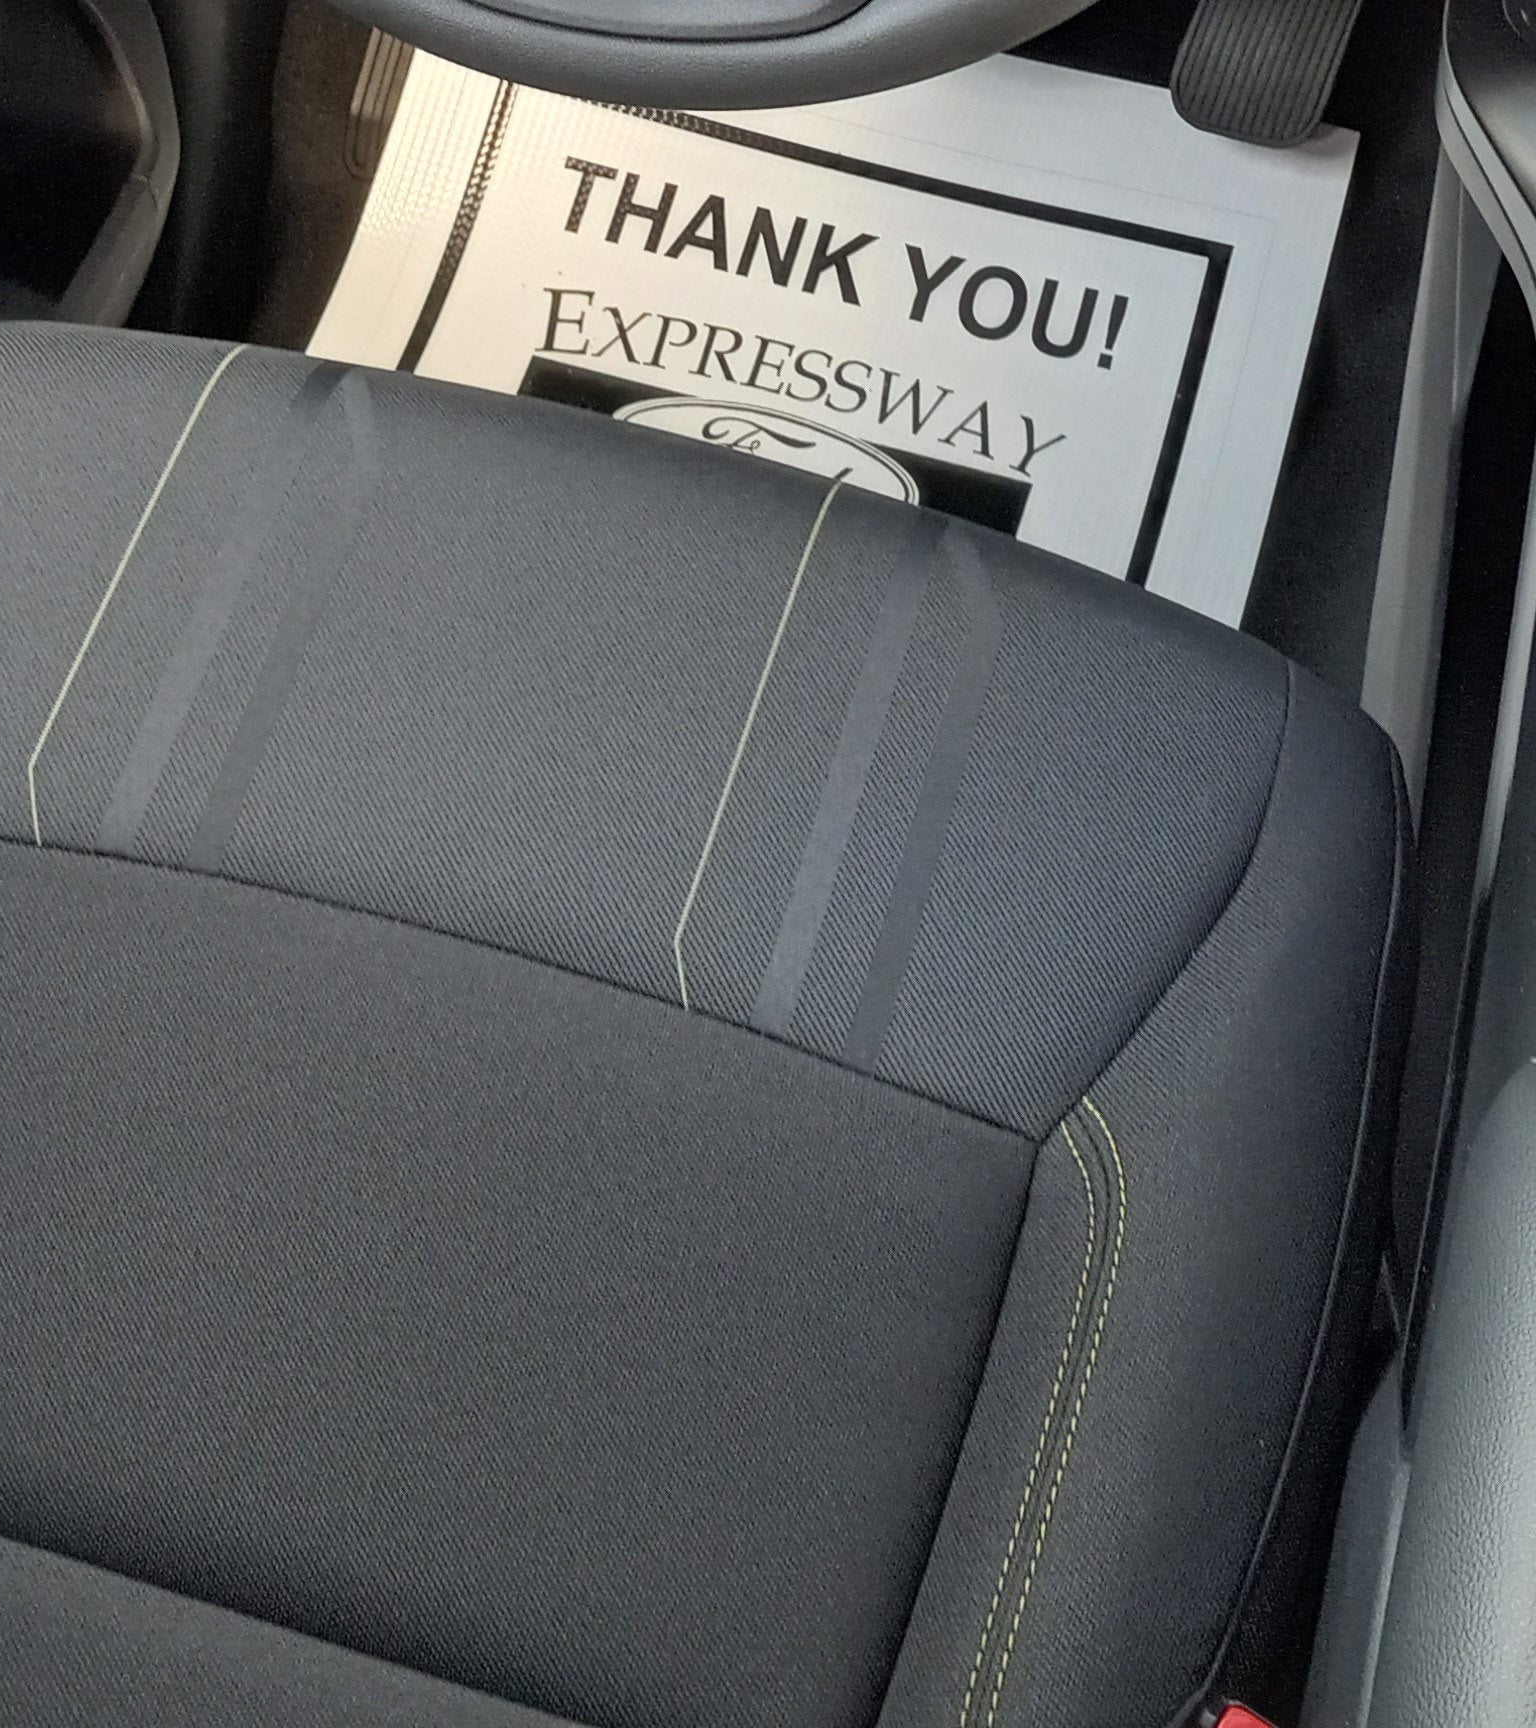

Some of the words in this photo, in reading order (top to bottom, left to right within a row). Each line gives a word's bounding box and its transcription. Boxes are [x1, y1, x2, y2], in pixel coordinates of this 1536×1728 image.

[562, 156, 880, 307] THANK
[899, 242, 1131, 372] YOU!
[534, 286, 1068, 479] EXPRESSWAY
